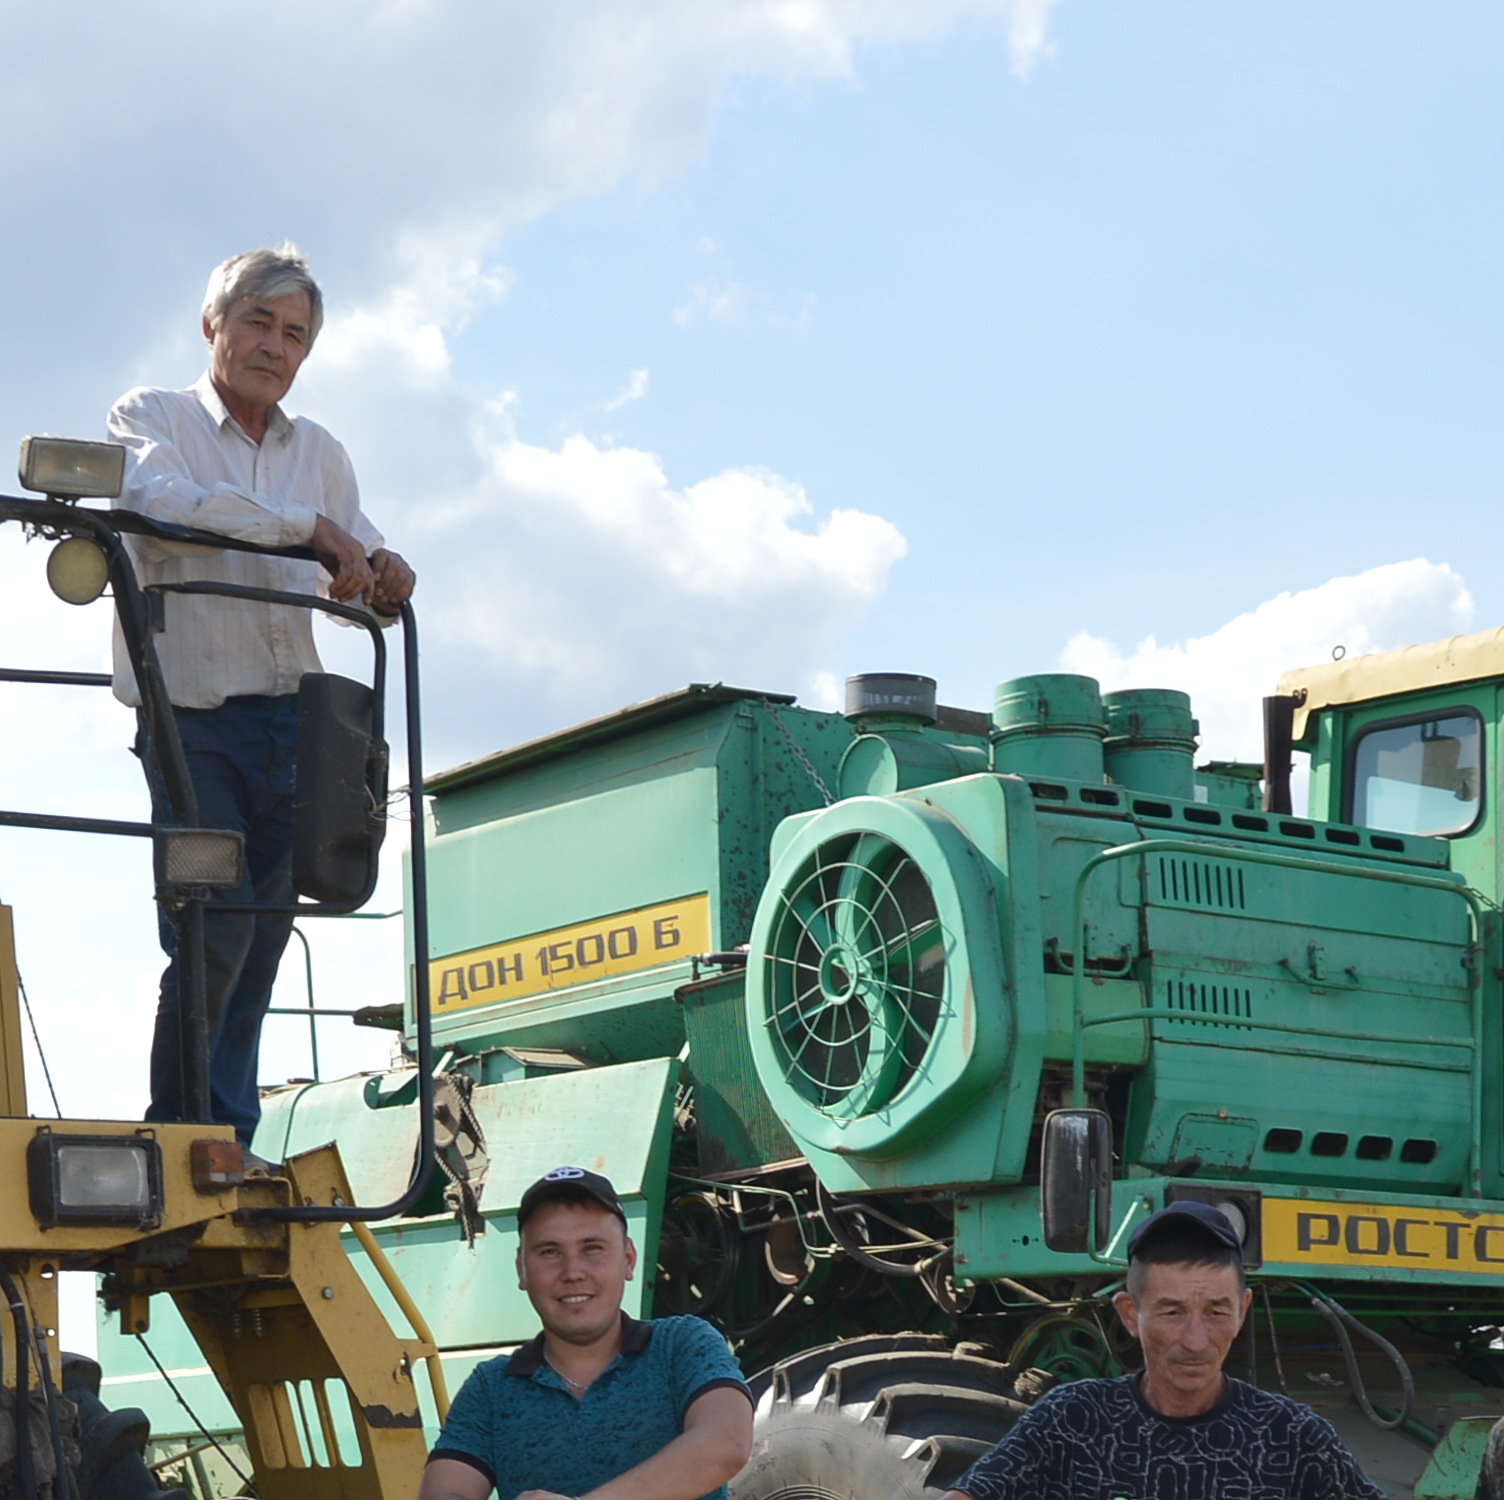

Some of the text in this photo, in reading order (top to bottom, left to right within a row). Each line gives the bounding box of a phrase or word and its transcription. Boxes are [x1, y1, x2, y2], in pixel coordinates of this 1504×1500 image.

[438, 915, 681, 1005] ДОН 1500 Б
